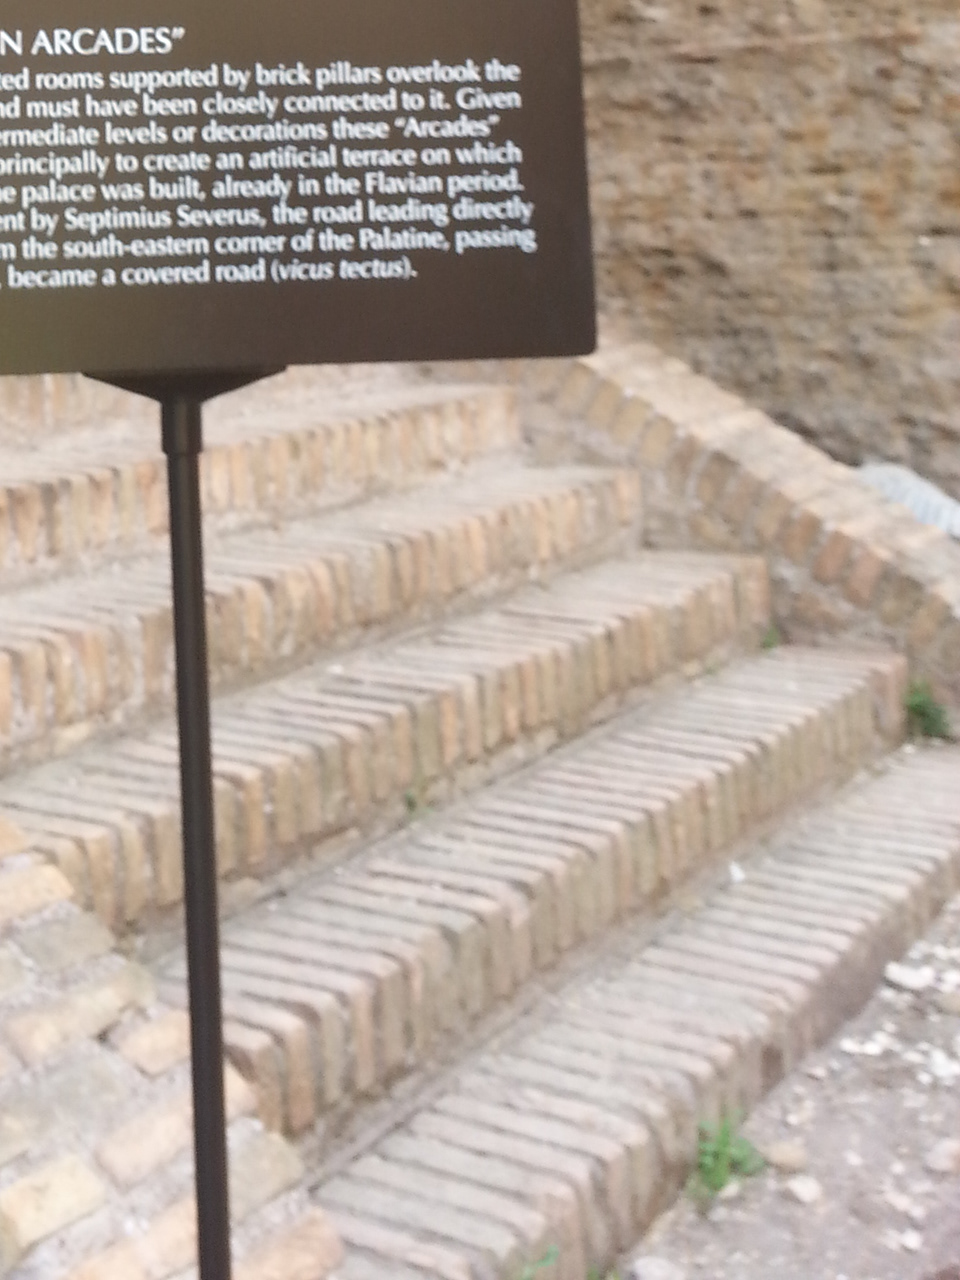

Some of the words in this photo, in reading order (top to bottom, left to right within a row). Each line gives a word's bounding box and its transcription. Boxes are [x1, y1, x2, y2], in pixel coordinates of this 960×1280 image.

[31, 26, 184, 56] ARCADES”
[35, 73, 104, 90] rooms
[109, 65, 218, 94] supported
[255, 64, 310, 86] brick
[315, 62, 382, 90] pillars
[386, 61, 480, 84] overlook
[485, 60, 520, 83] the
[26, 98, 79, 118] must
[85, 94, 138, 117] have
[142, 93, 197, 116] been
[202, 91, 278, 120] closely
[283, 89, 397, 113] connected
[429, 88, 450, 111] it.
[455, 87, 521, 110] Given
[105, 122, 167, 145] levels
[201, 119, 327, 143] decorations
[332, 118, 389, 141] these
[394, 115, 498, 139] “Arcades”
[142, 151, 211, 172] create
[248, 146, 337, 170] artificial
[342, 147, 417, 168] terrace
[455, 142, 522, 165] which
[21, 179, 96, 208] palace
[100, 184, 144, 201] was
[149, 177, 205, 202] built,
[212, 175, 291, 204] already
[324, 173, 360, 196] the
[365, 171, 442, 195] Flavian
[447, 169, 523, 198] period.
[30, 209, 58, 237] by
[64, 207, 172, 236] Septimius
[176, 204, 266, 231] Severus,
[272, 203, 308, 226] the
[312, 202, 363, 225] road
[368, 200, 449, 229] leading
[452, 198, 532, 227] directly
[21, 237, 58, 260] the
[62, 234, 209, 259] south-eastern
[214, 238, 285, 256] corner
[318, 230, 354, 253] the
[359, 228, 449, 254] Palatine,
[455, 226, 536, 255] passing
[7, 265, 97, 289] became
[121, 262, 210, 286] covered
[215, 261, 265, 284] road
[270, 259, 333, 288] (vicus
[339, 259, 416, 281] tectus).
